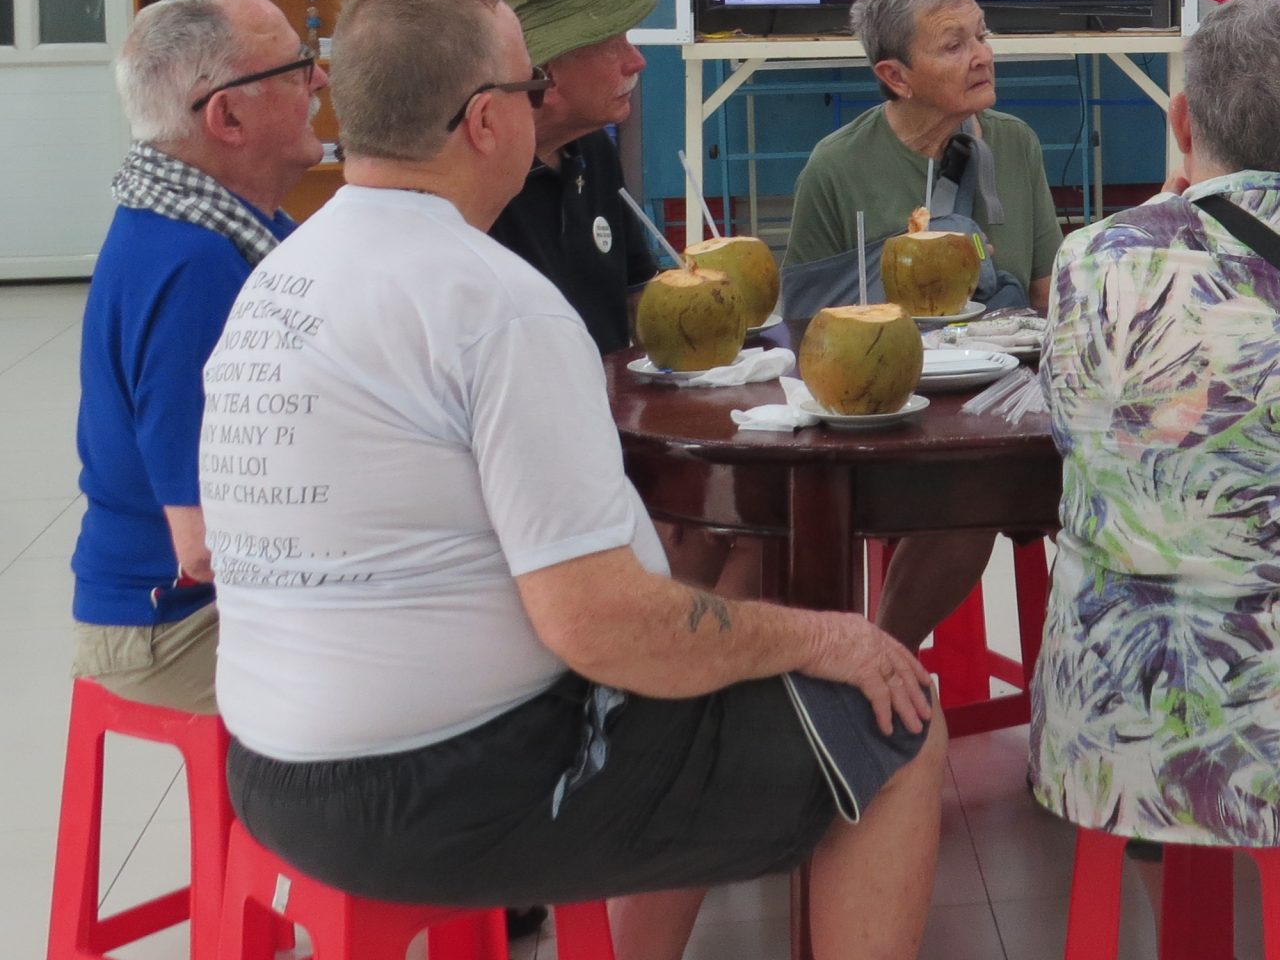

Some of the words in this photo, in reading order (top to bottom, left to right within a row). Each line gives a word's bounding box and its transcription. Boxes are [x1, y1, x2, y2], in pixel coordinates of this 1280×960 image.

[281, 276, 315, 298] LOI
[240, 330, 274, 350] BUY
[248, 362, 282, 382] TEA
[224, 393, 250, 414] TEA
[256, 393, 320, 415] COST
[220, 424, 269, 445] MANY
[275, 425, 296, 446] Pi
[212, 454, 234, 474] DAI
[238, 456, 268, 476] LOI
[234, 484, 330, 504] CHARLIE
